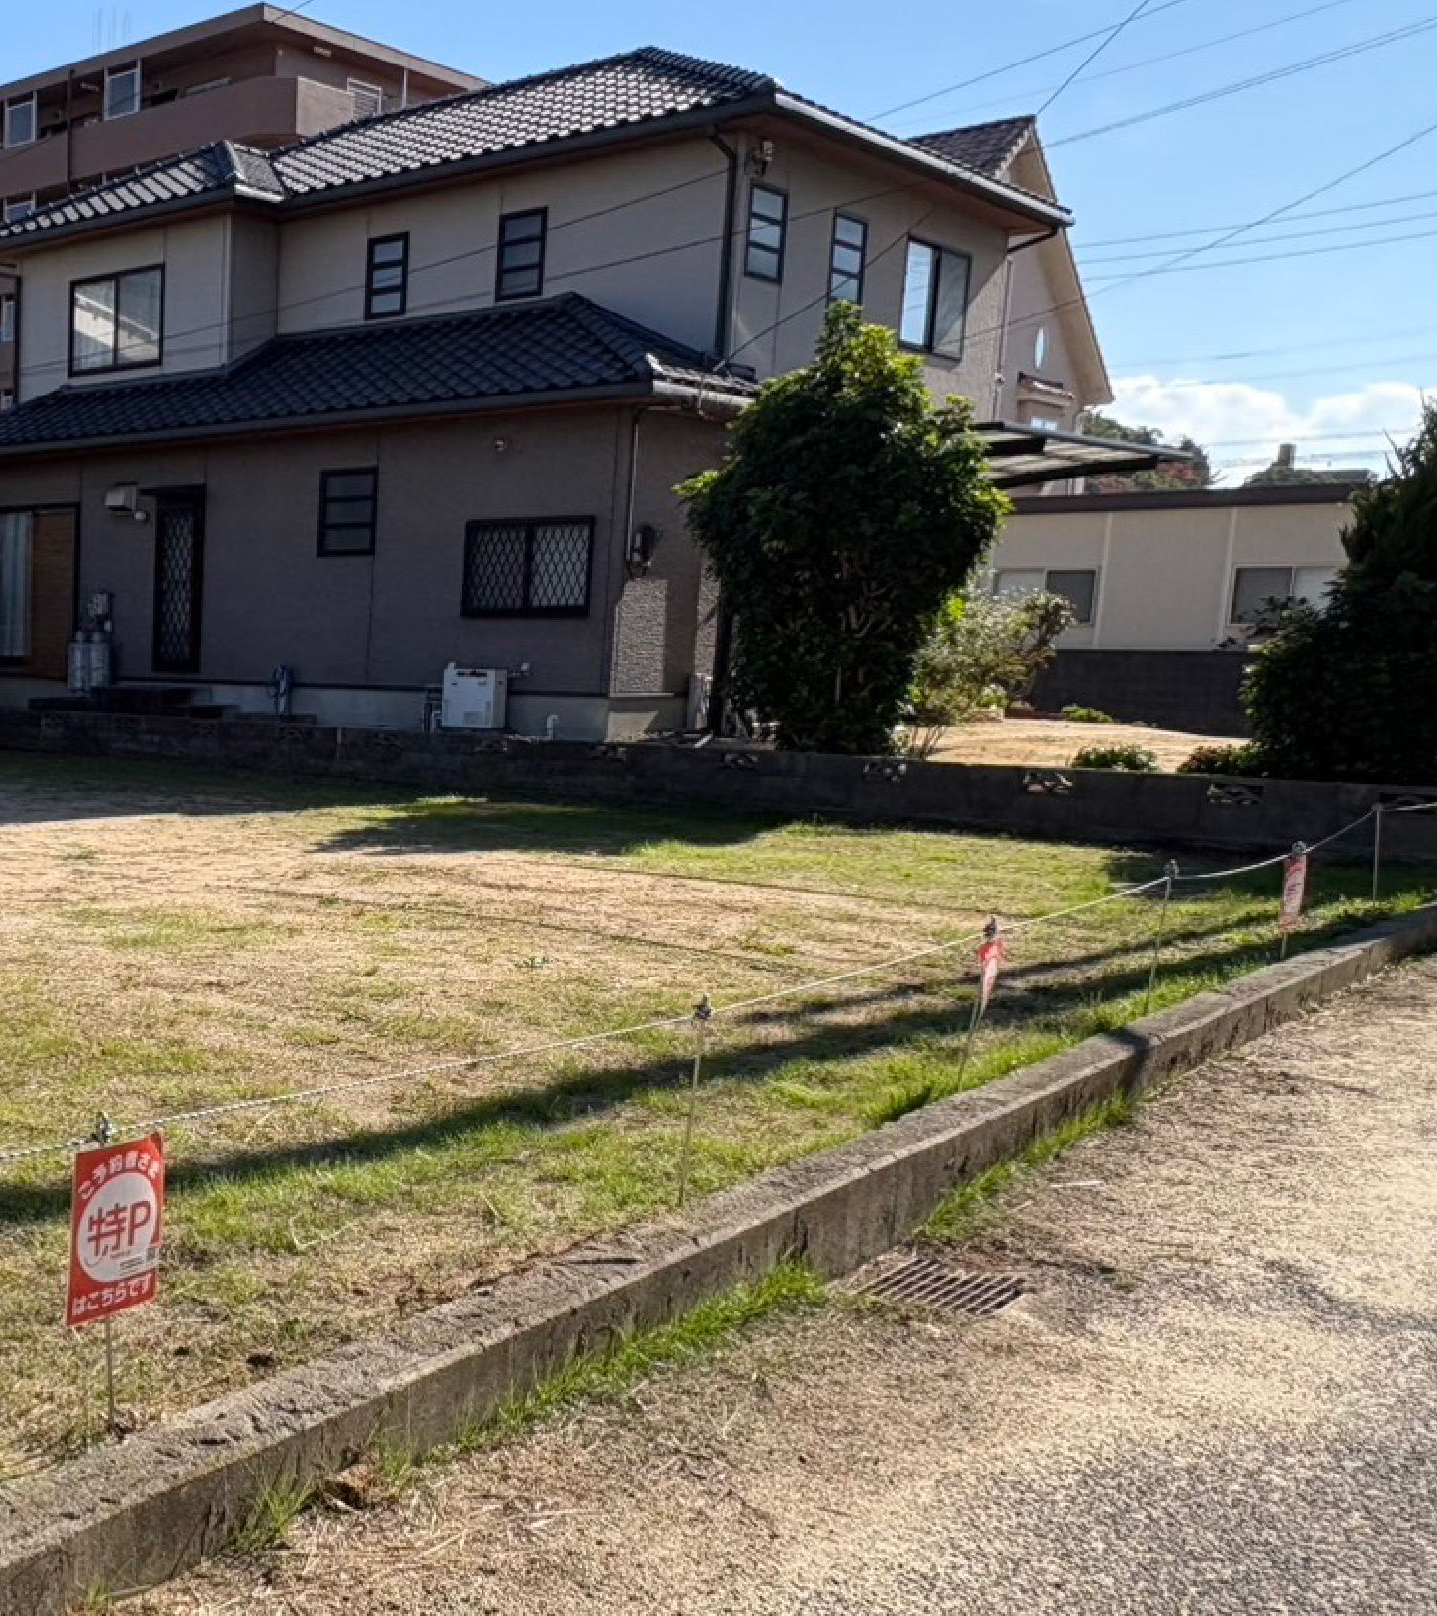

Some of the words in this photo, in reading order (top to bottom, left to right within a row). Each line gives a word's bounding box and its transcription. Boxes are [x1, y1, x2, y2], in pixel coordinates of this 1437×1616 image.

[87, 1200, 152, 1257] 特P
[71, 1273, 152, 1316] はこちらです
